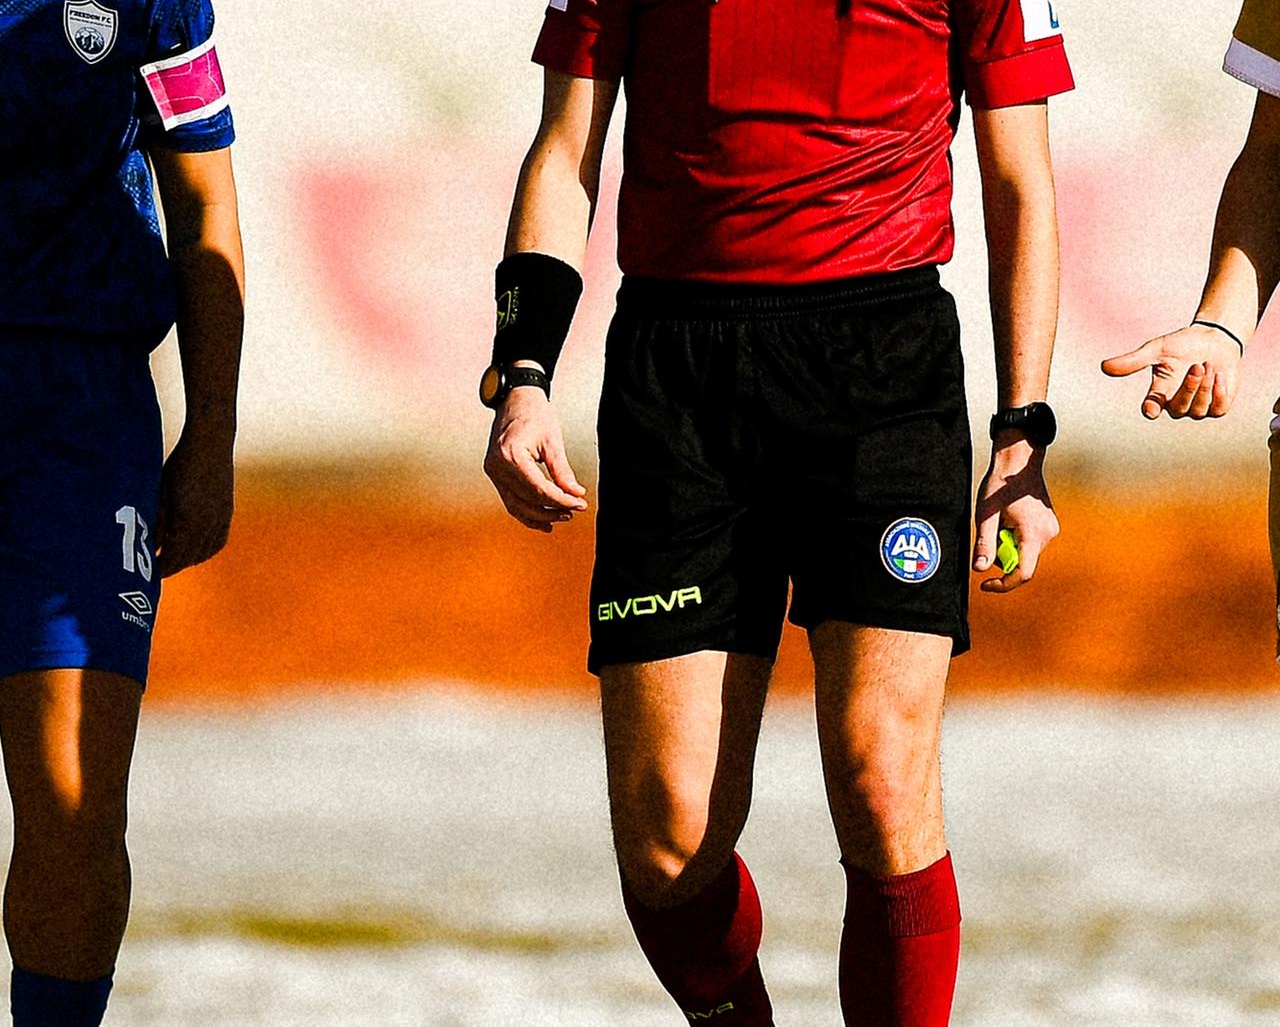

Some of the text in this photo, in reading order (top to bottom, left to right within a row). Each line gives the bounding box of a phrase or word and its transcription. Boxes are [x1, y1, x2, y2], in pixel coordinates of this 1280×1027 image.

[115, 505, 153, 583] 13
[890, 533, 931, 561] AIA
[598, 585, 702, 621] GIVOVA
